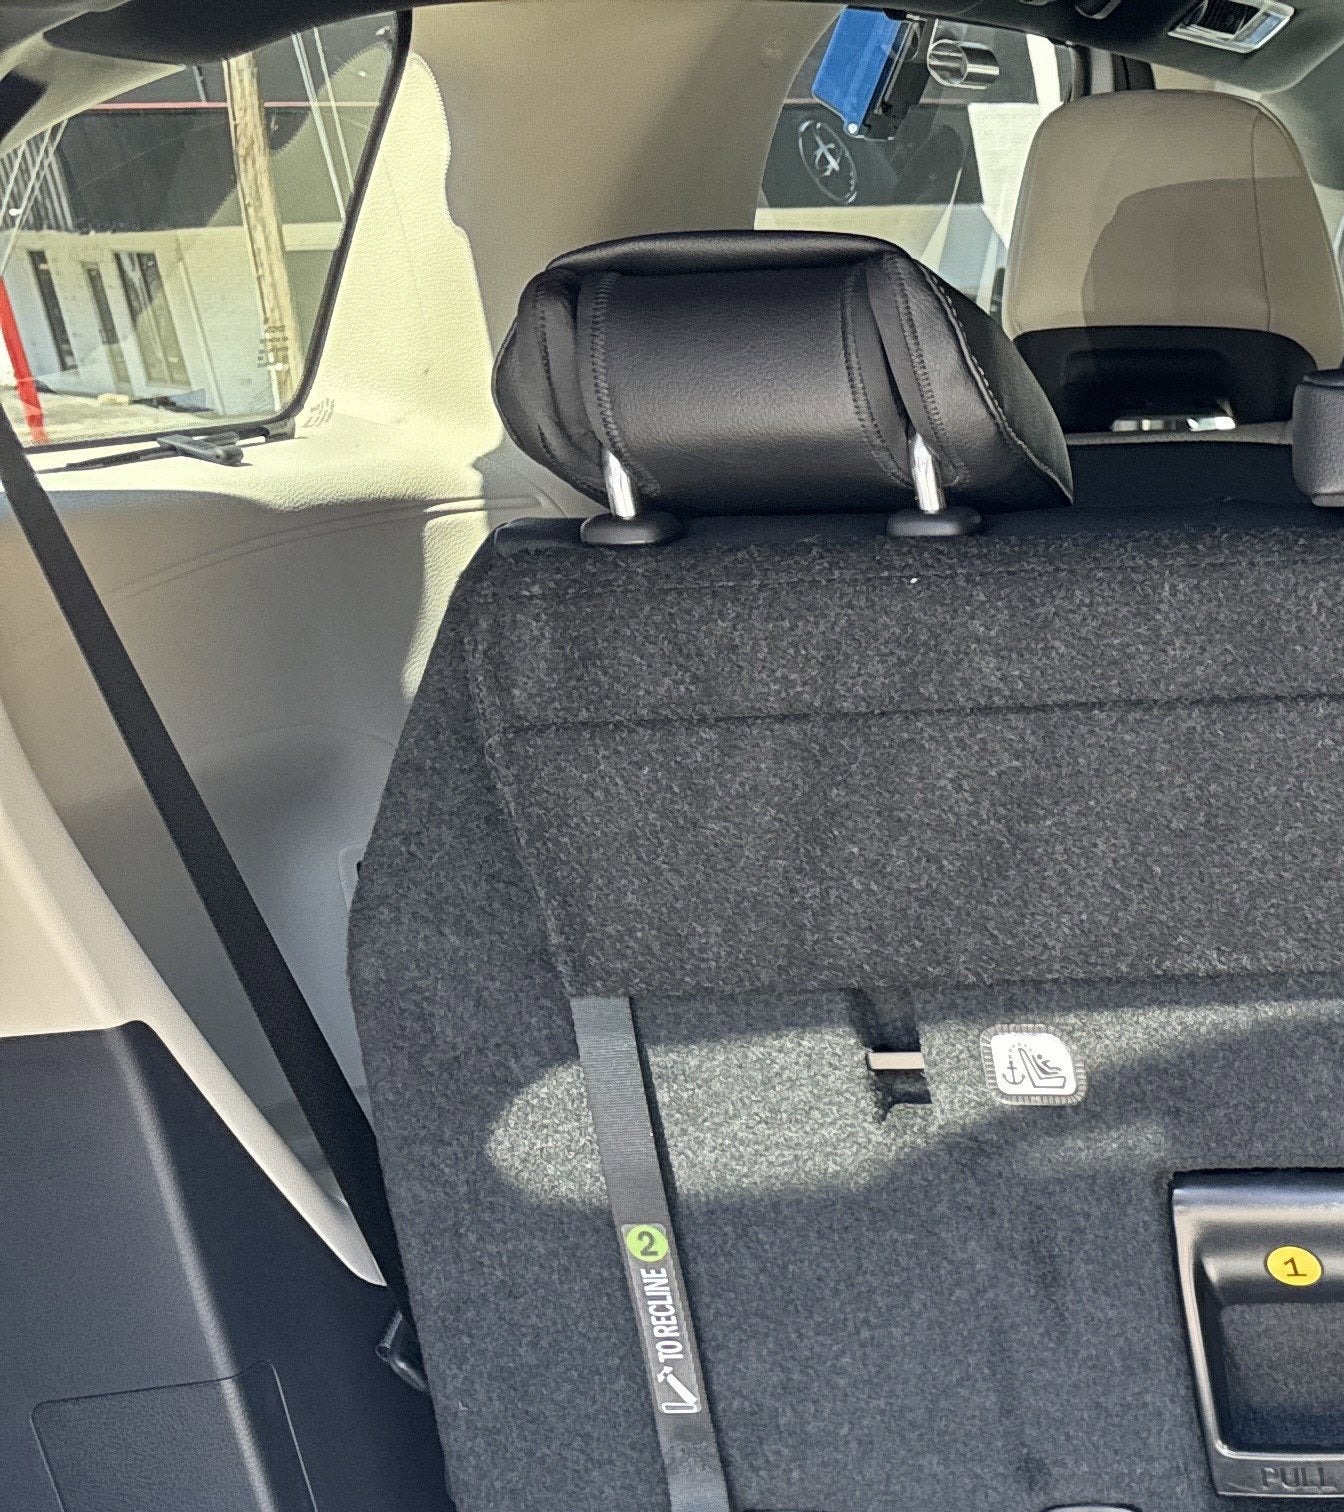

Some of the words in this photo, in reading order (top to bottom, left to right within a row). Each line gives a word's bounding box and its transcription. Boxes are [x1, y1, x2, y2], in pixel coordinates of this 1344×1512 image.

[637, 1231, 658, 1256] 2
[1284, 1258, 1307, 1276] 1
[640, 1268, 679, 1337] RECLINE
[655, 1341, 683, 1363] TO
[1261, 1467, 1336, 1491] PULL
